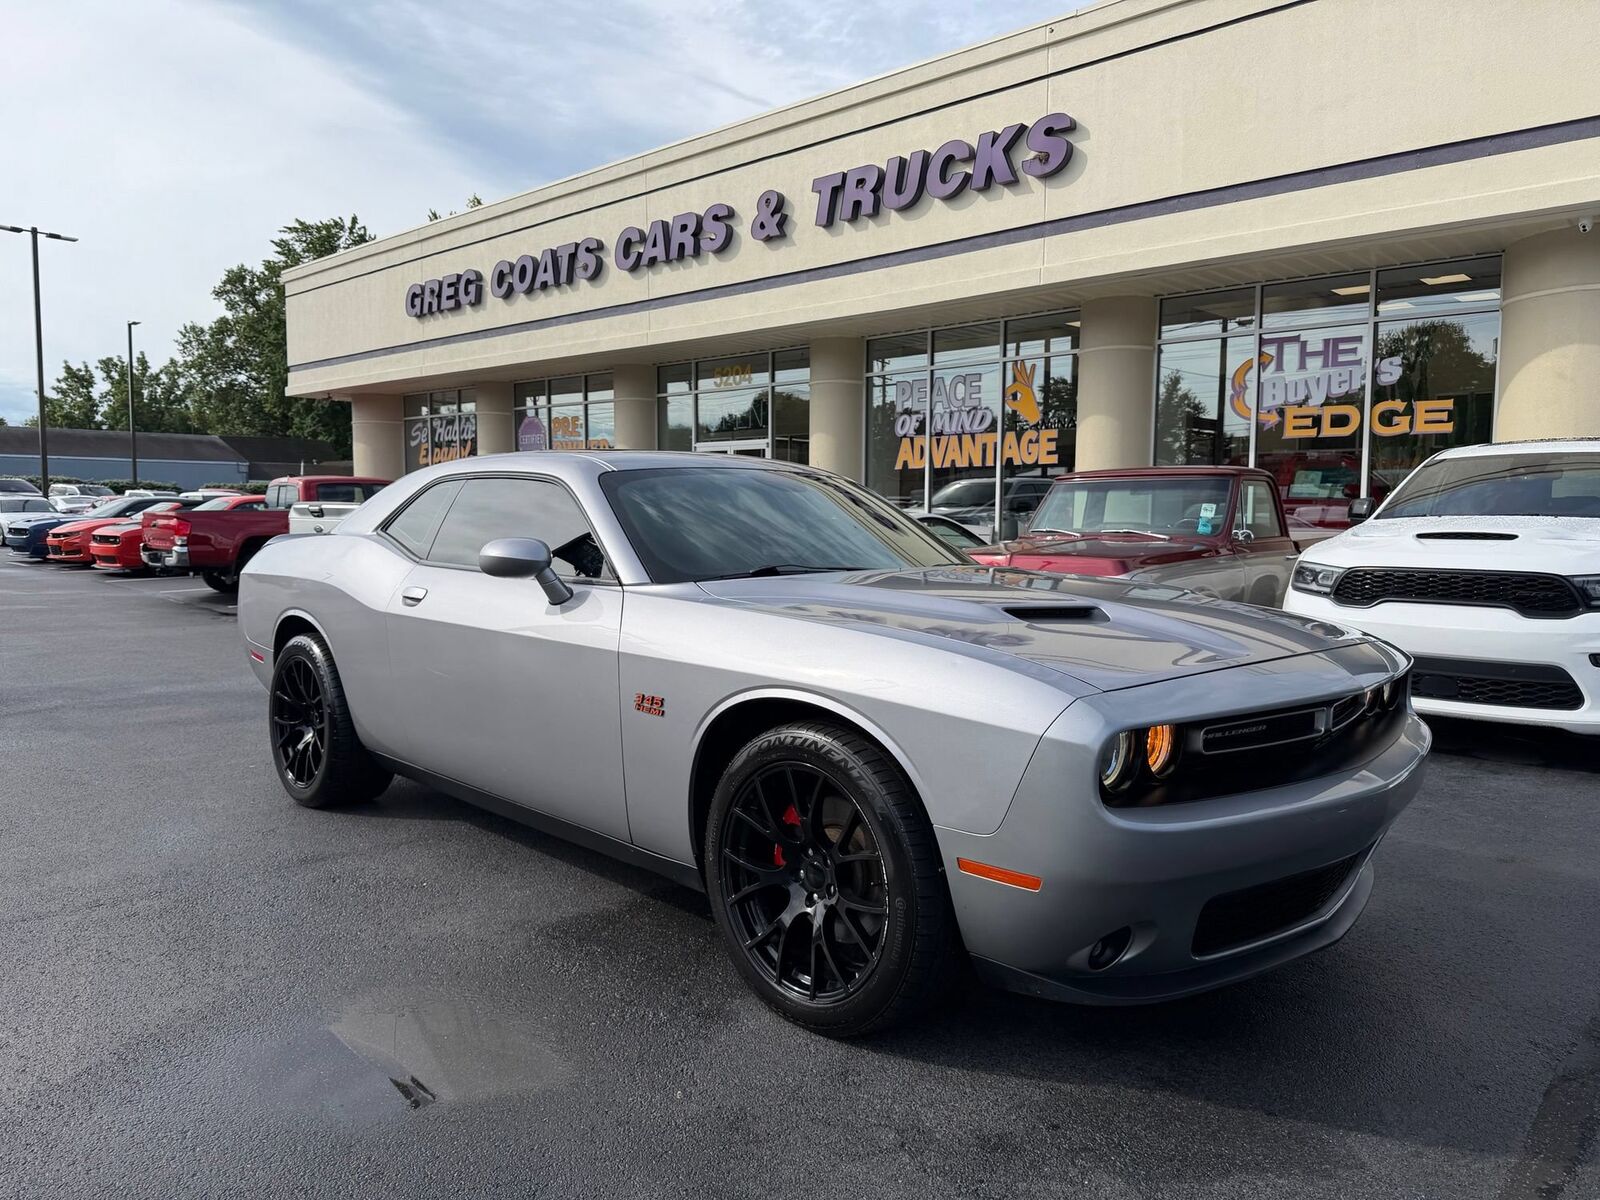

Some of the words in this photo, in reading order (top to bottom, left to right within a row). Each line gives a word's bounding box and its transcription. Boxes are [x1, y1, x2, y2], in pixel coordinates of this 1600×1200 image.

[405, 269, 482, 318] GREG
[491, 237, 604, 299] COATS
[614, 203, 734, 271] CARS
[751, 190, 787, 242] &
[812, 112, 1077, 227] TRUCKS
[1261, 334, 1363, 373] THE
[895, 373, 982, 411] PEACE
[410, 422, 428, 447] Se
[895, 412, 923, 437] OF
[931, 407, 993, 435] MIND
[1282, 399, 1455, 439] EDGE
[895, 428, 1058, 470] ADVANTAGE
[634, 692, 665, 708] 345
[634, 702, 665, 717] HEMI
